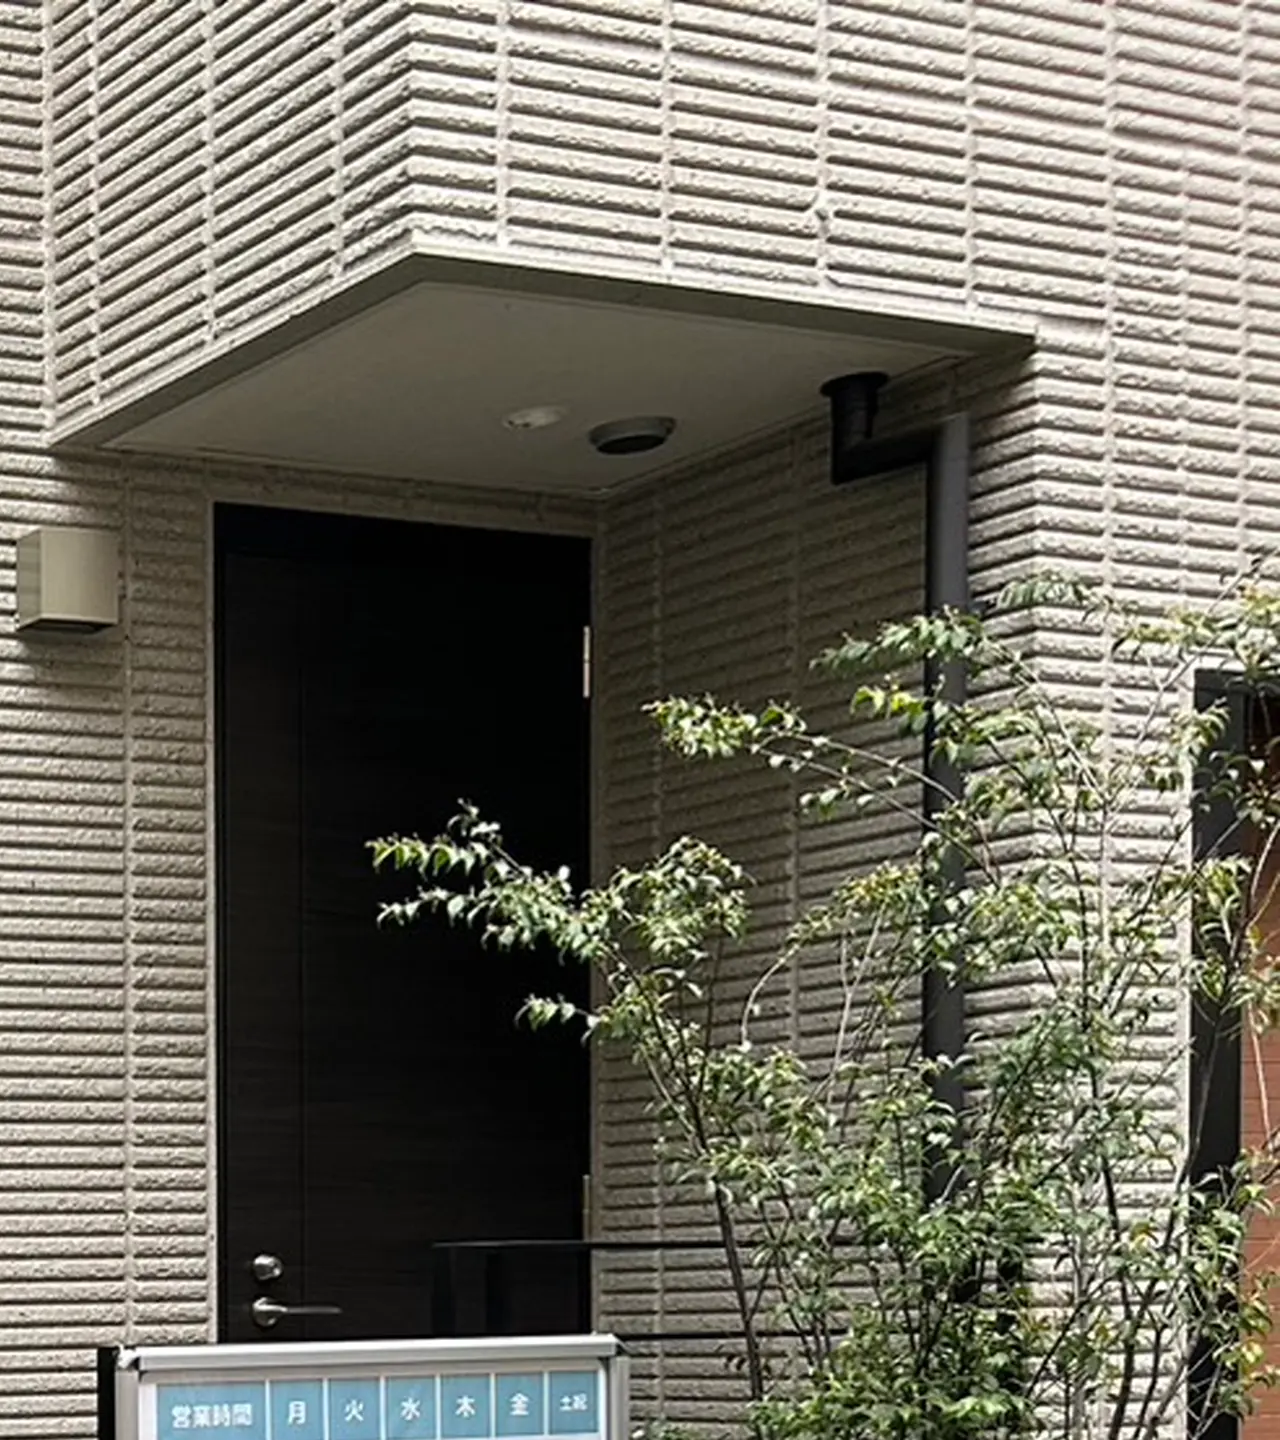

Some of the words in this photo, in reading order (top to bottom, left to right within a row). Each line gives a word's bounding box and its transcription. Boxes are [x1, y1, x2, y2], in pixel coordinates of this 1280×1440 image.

[171, 1403, 253, 1429] 営業時間
[287, 1400, 307, 1425] 月
[344, 1399, 364, 1423] 火
[399, 1396, 421, 1421] 水
[454, 1395, 476, 1418] 木
[509, 1392, 530, 1416] 金
